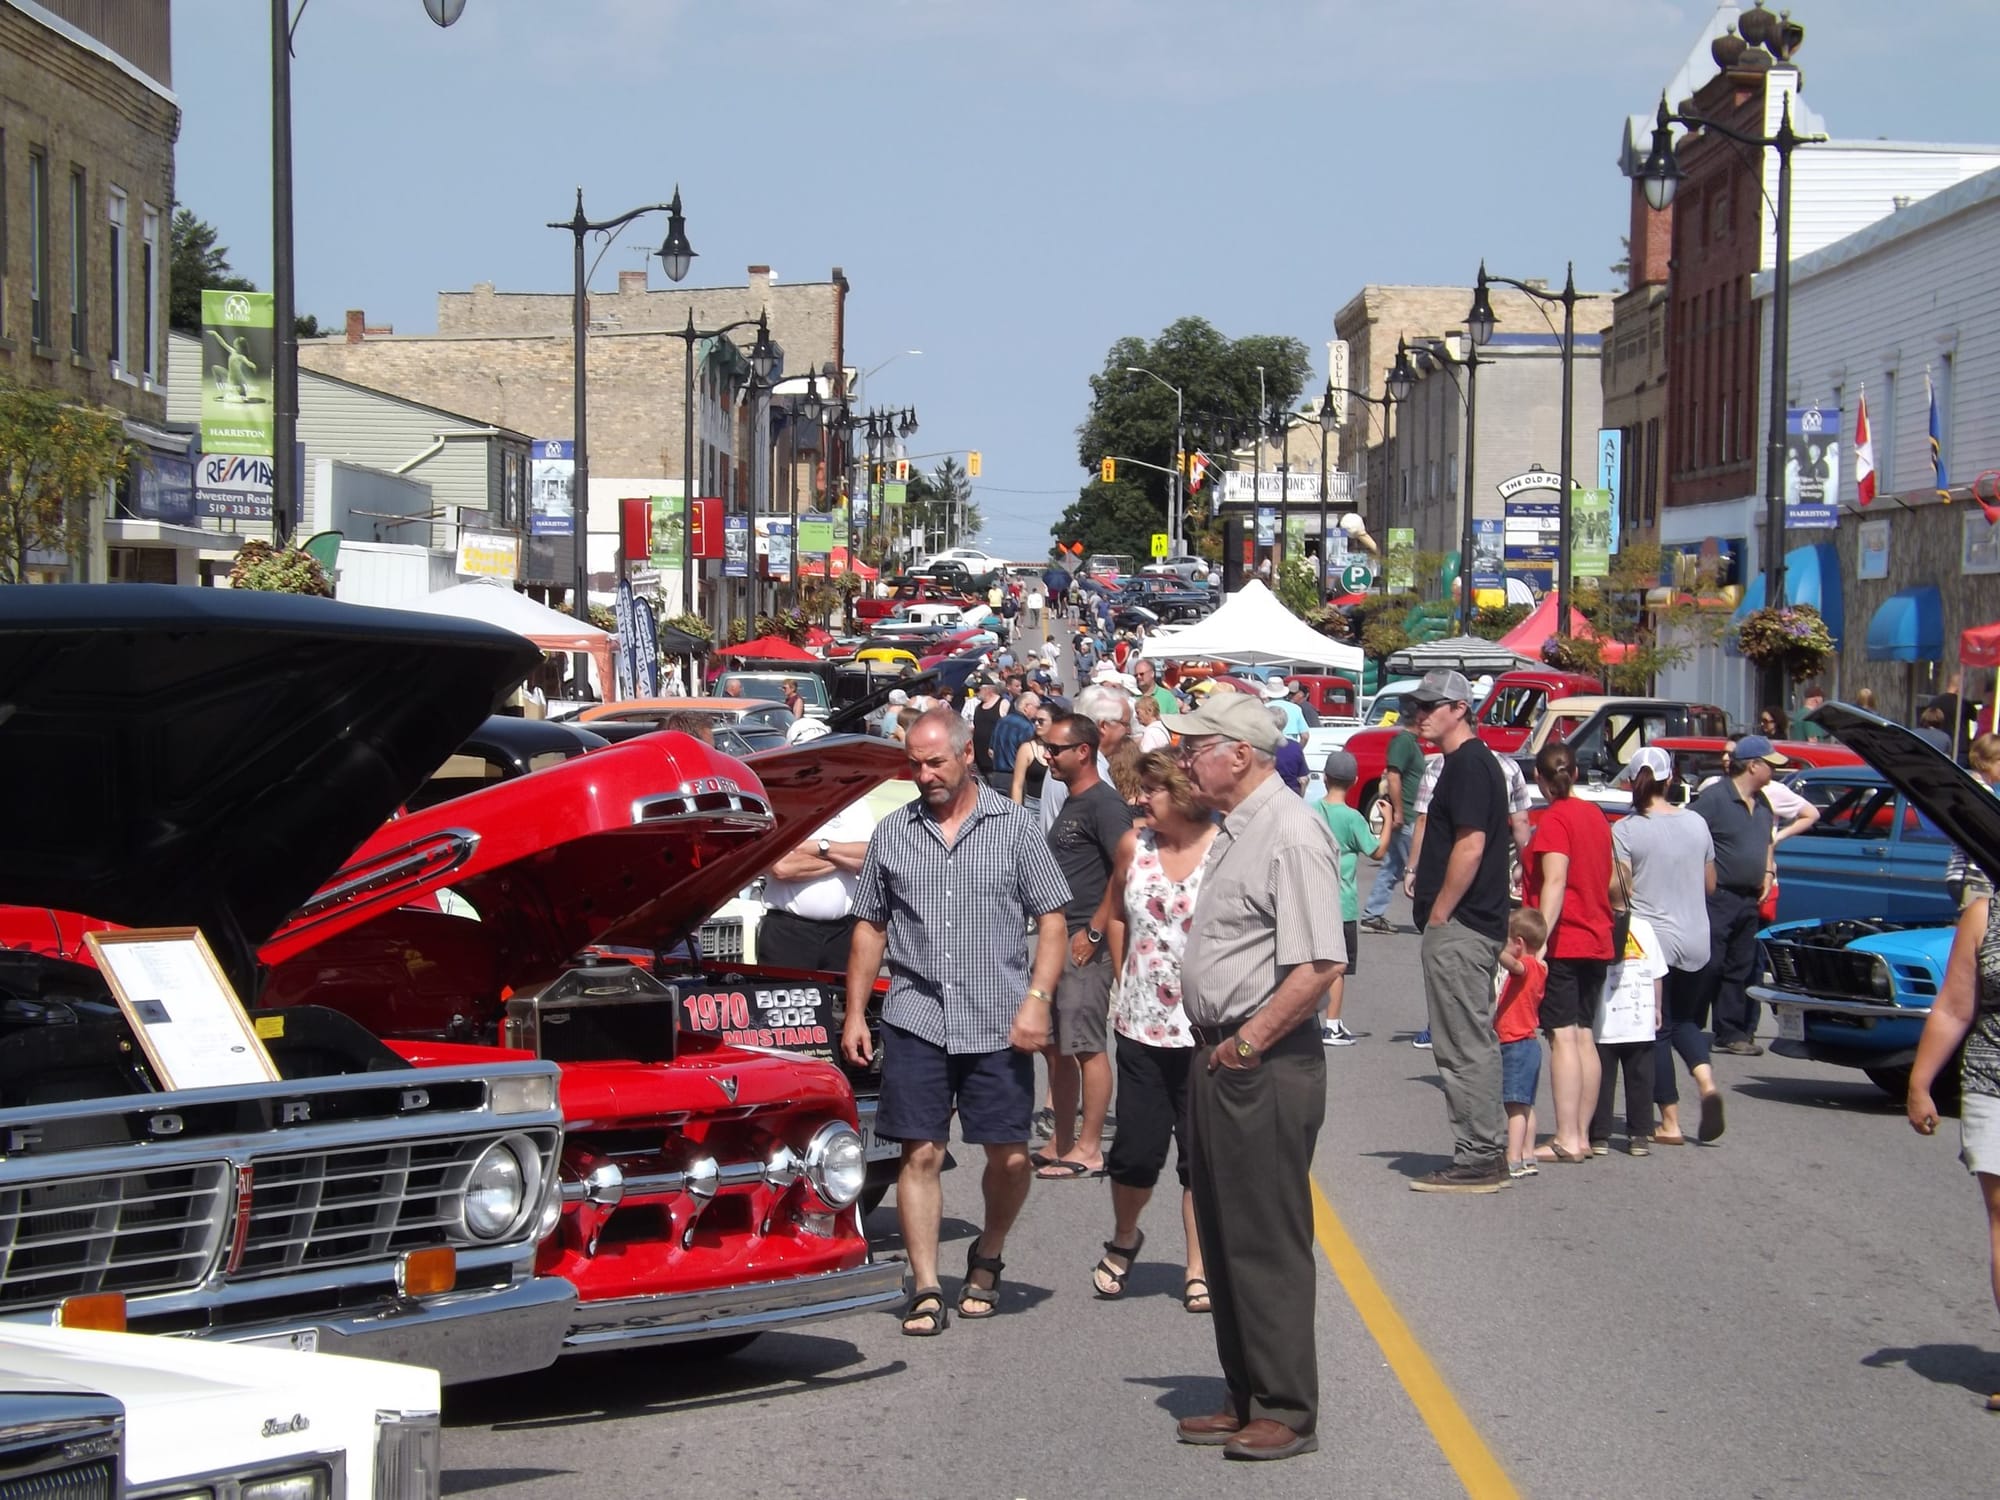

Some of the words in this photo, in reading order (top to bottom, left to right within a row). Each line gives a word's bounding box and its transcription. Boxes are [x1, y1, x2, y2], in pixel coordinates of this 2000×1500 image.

[209, 428, 266, 438] HARRISTON
[1241, 475, 1270, 490] HARY
[1274, 477, 1316, 490] SONE'S
[1506, 480, 1522, 490] THE
[1525, 476, 1542, 484] OLD
[1547, 477, 1561, 485] PO
[247, 493, 273, 505] Realt
[1351, 567, 1364, 582] P
[691, 778, 740, 796] FORD
[683, 992, 750, 1031] 1970
[755, 988, 822, 1009] BOSS
[766, 1008, 817, 1027] 302
[722, 1026, 828, 1047] MUSTANG
[10, 1090, 430, 1152] FORD
